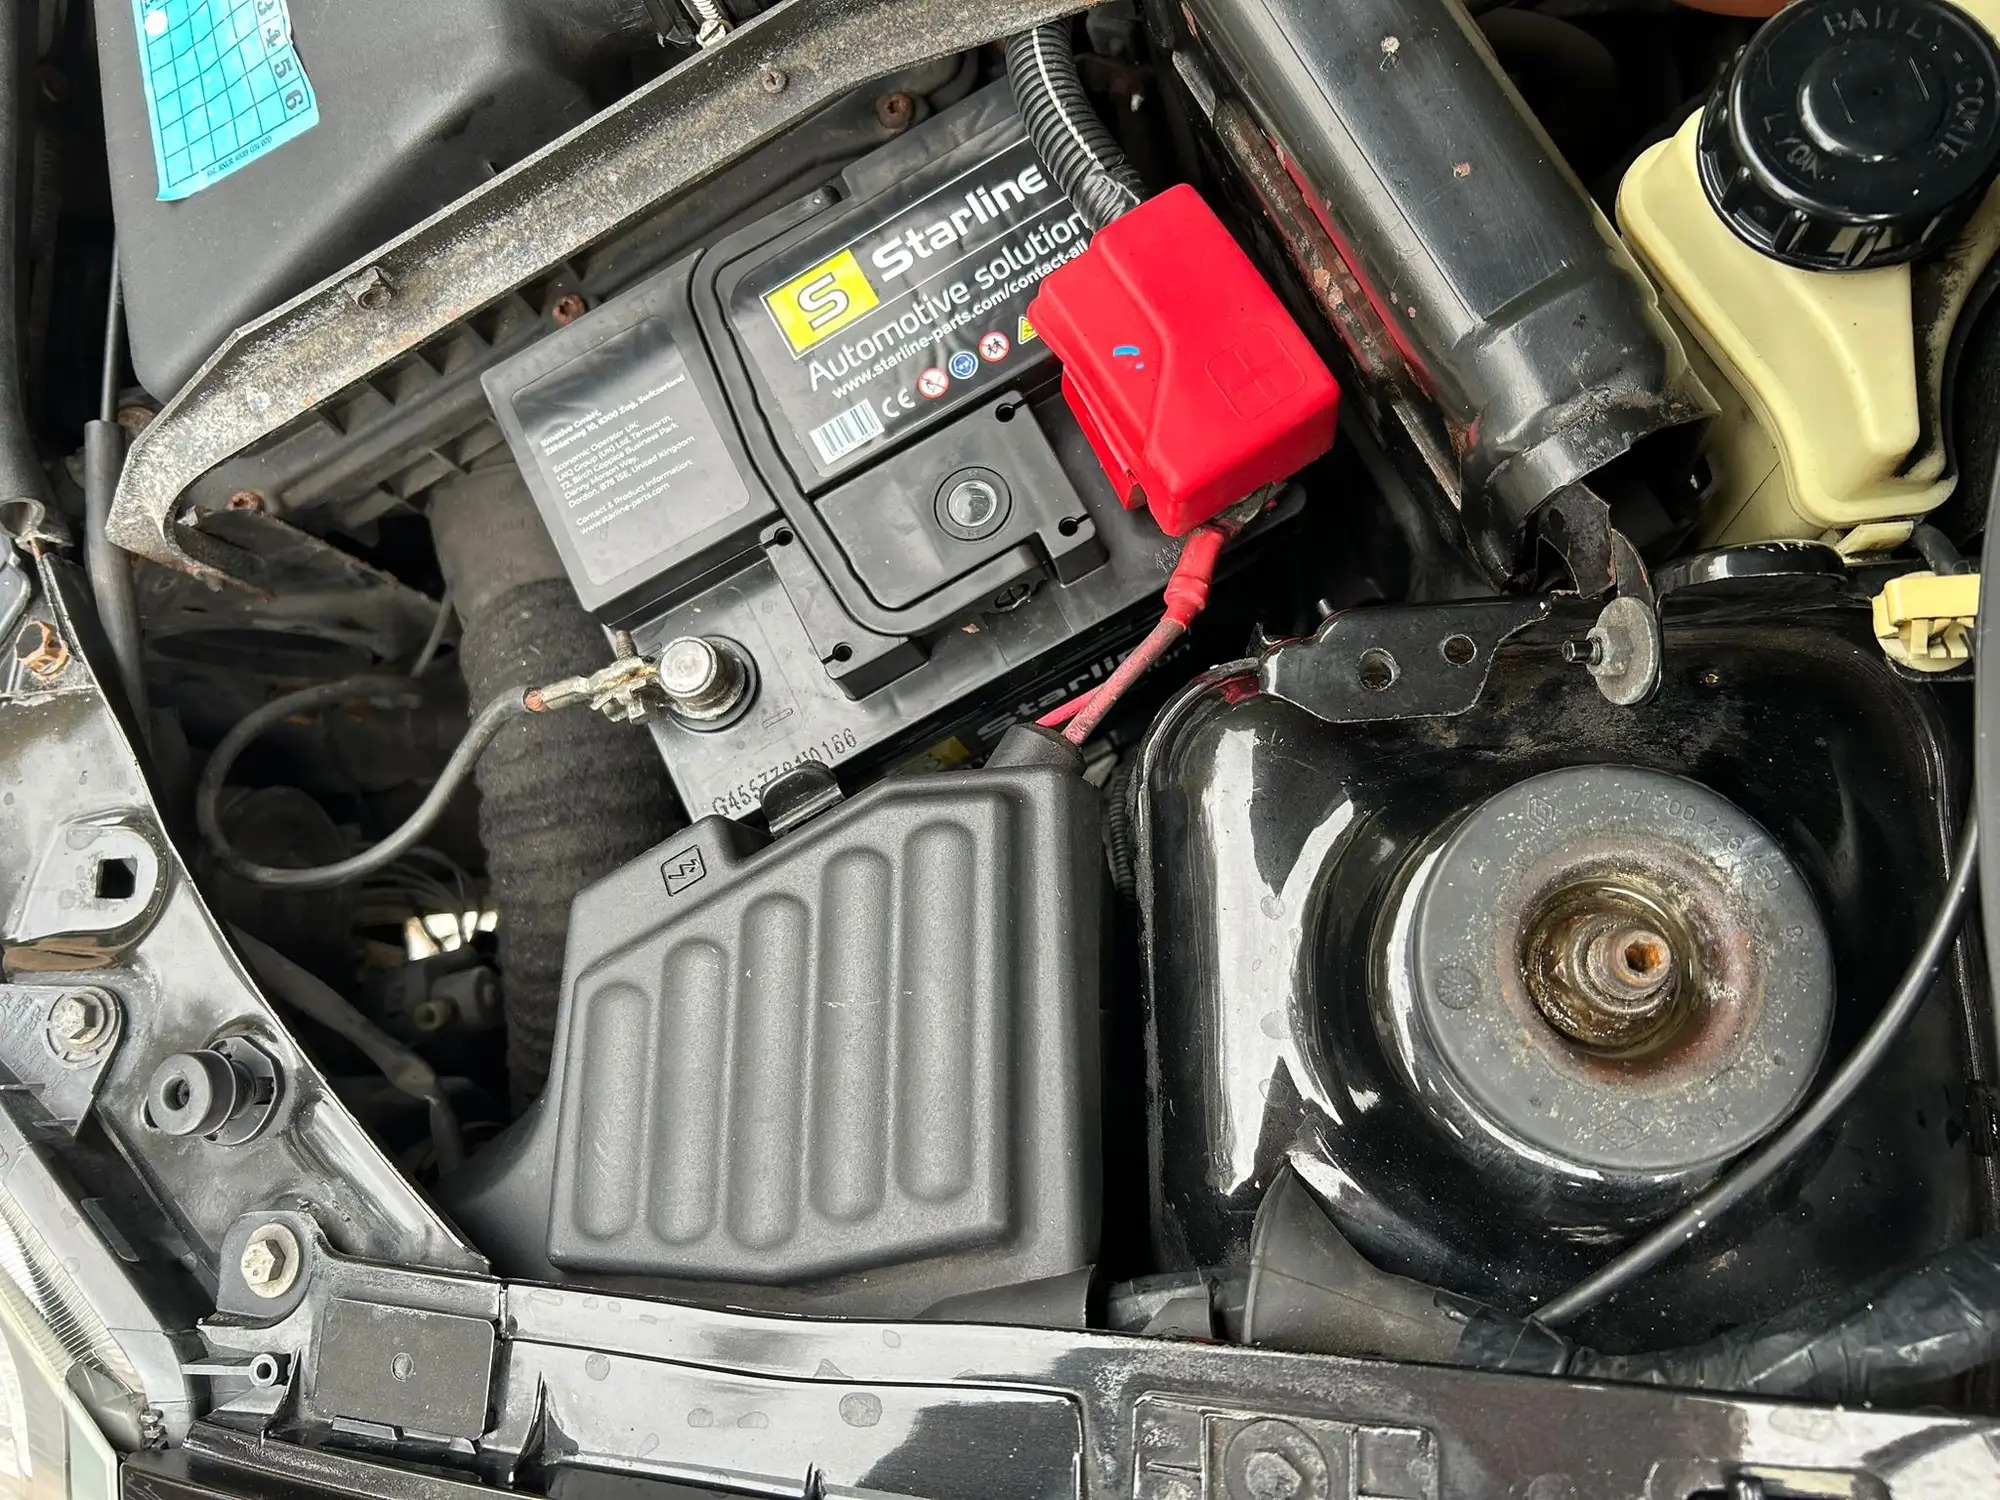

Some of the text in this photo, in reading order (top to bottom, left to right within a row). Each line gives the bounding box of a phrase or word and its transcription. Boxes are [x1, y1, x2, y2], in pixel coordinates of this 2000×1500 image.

[265, 27, 281, 49] 4
[273, 56, 294, 79] 5
[285, 88, 304, 111] 6
[871, 164, 1048, 283] Starline
[797, 271, 850, 333] S
[831, 236, 1089, 399] www.starline-parts.com/contact-all
[808, 281, 971, 393] Automotive
[637, 372, 686, 404] Switzerland
[882, 387, 916, 418] CE
[552, 448, 591, 474] Economic
[590, 430, 624, 452] Operator
[572, 468, 593, 485] Birch
[593, 451, 625, 472] Coppice
[624, 432, 660, 456] Business
[659, 422, 679, 437] Park
[573, 455, 598, 473] Group
[631, 453, 659, 474] United
[657, 435, 696, 460] Kingdom
[564, 482, 590, 500] Danny
[576, 505, 607, 527] Contact
[607, 500, 615, 510] &
[614, 484, 646, 505] Product
[580, 482, 671, 535] www.starline-parts.com
